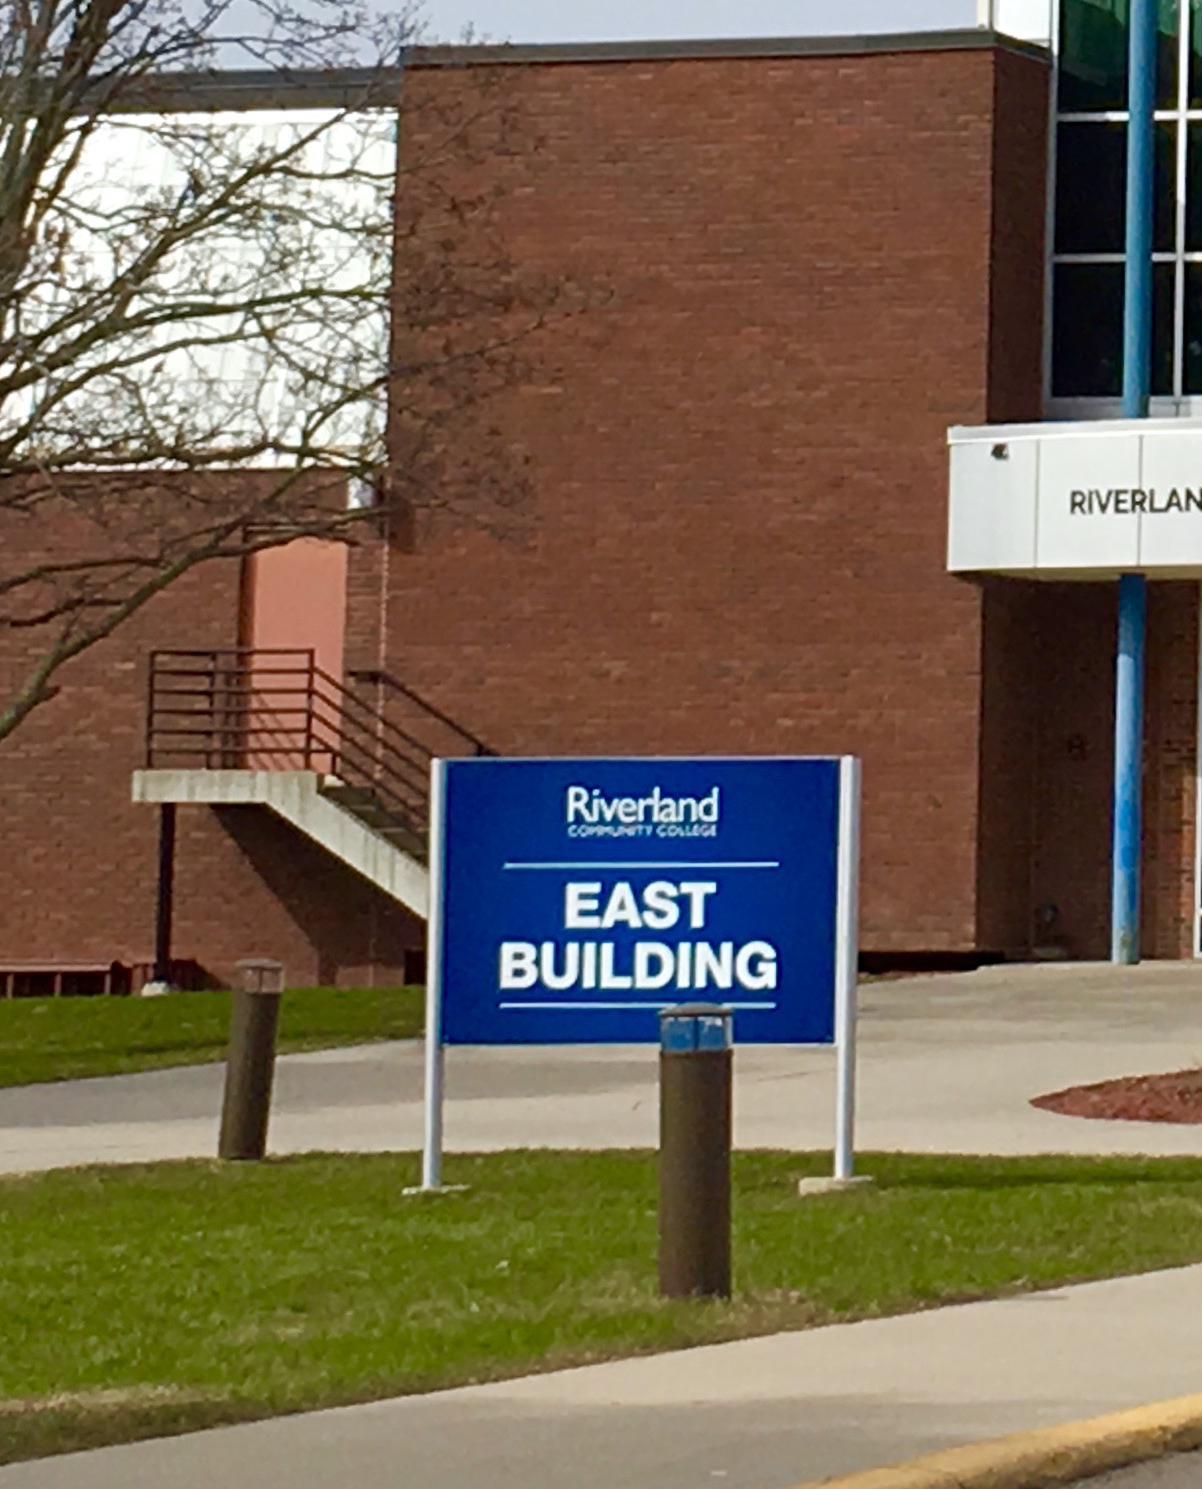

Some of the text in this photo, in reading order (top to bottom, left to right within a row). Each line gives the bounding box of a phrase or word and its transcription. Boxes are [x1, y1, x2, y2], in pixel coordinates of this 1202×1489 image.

[567, 785, 720, 823] Riverland
[567, 824, 717, 838] COMMUNITY COLLEGE
[564, 881, 717, 929] EAST
[499, 940, 778, 990] BUILDING
